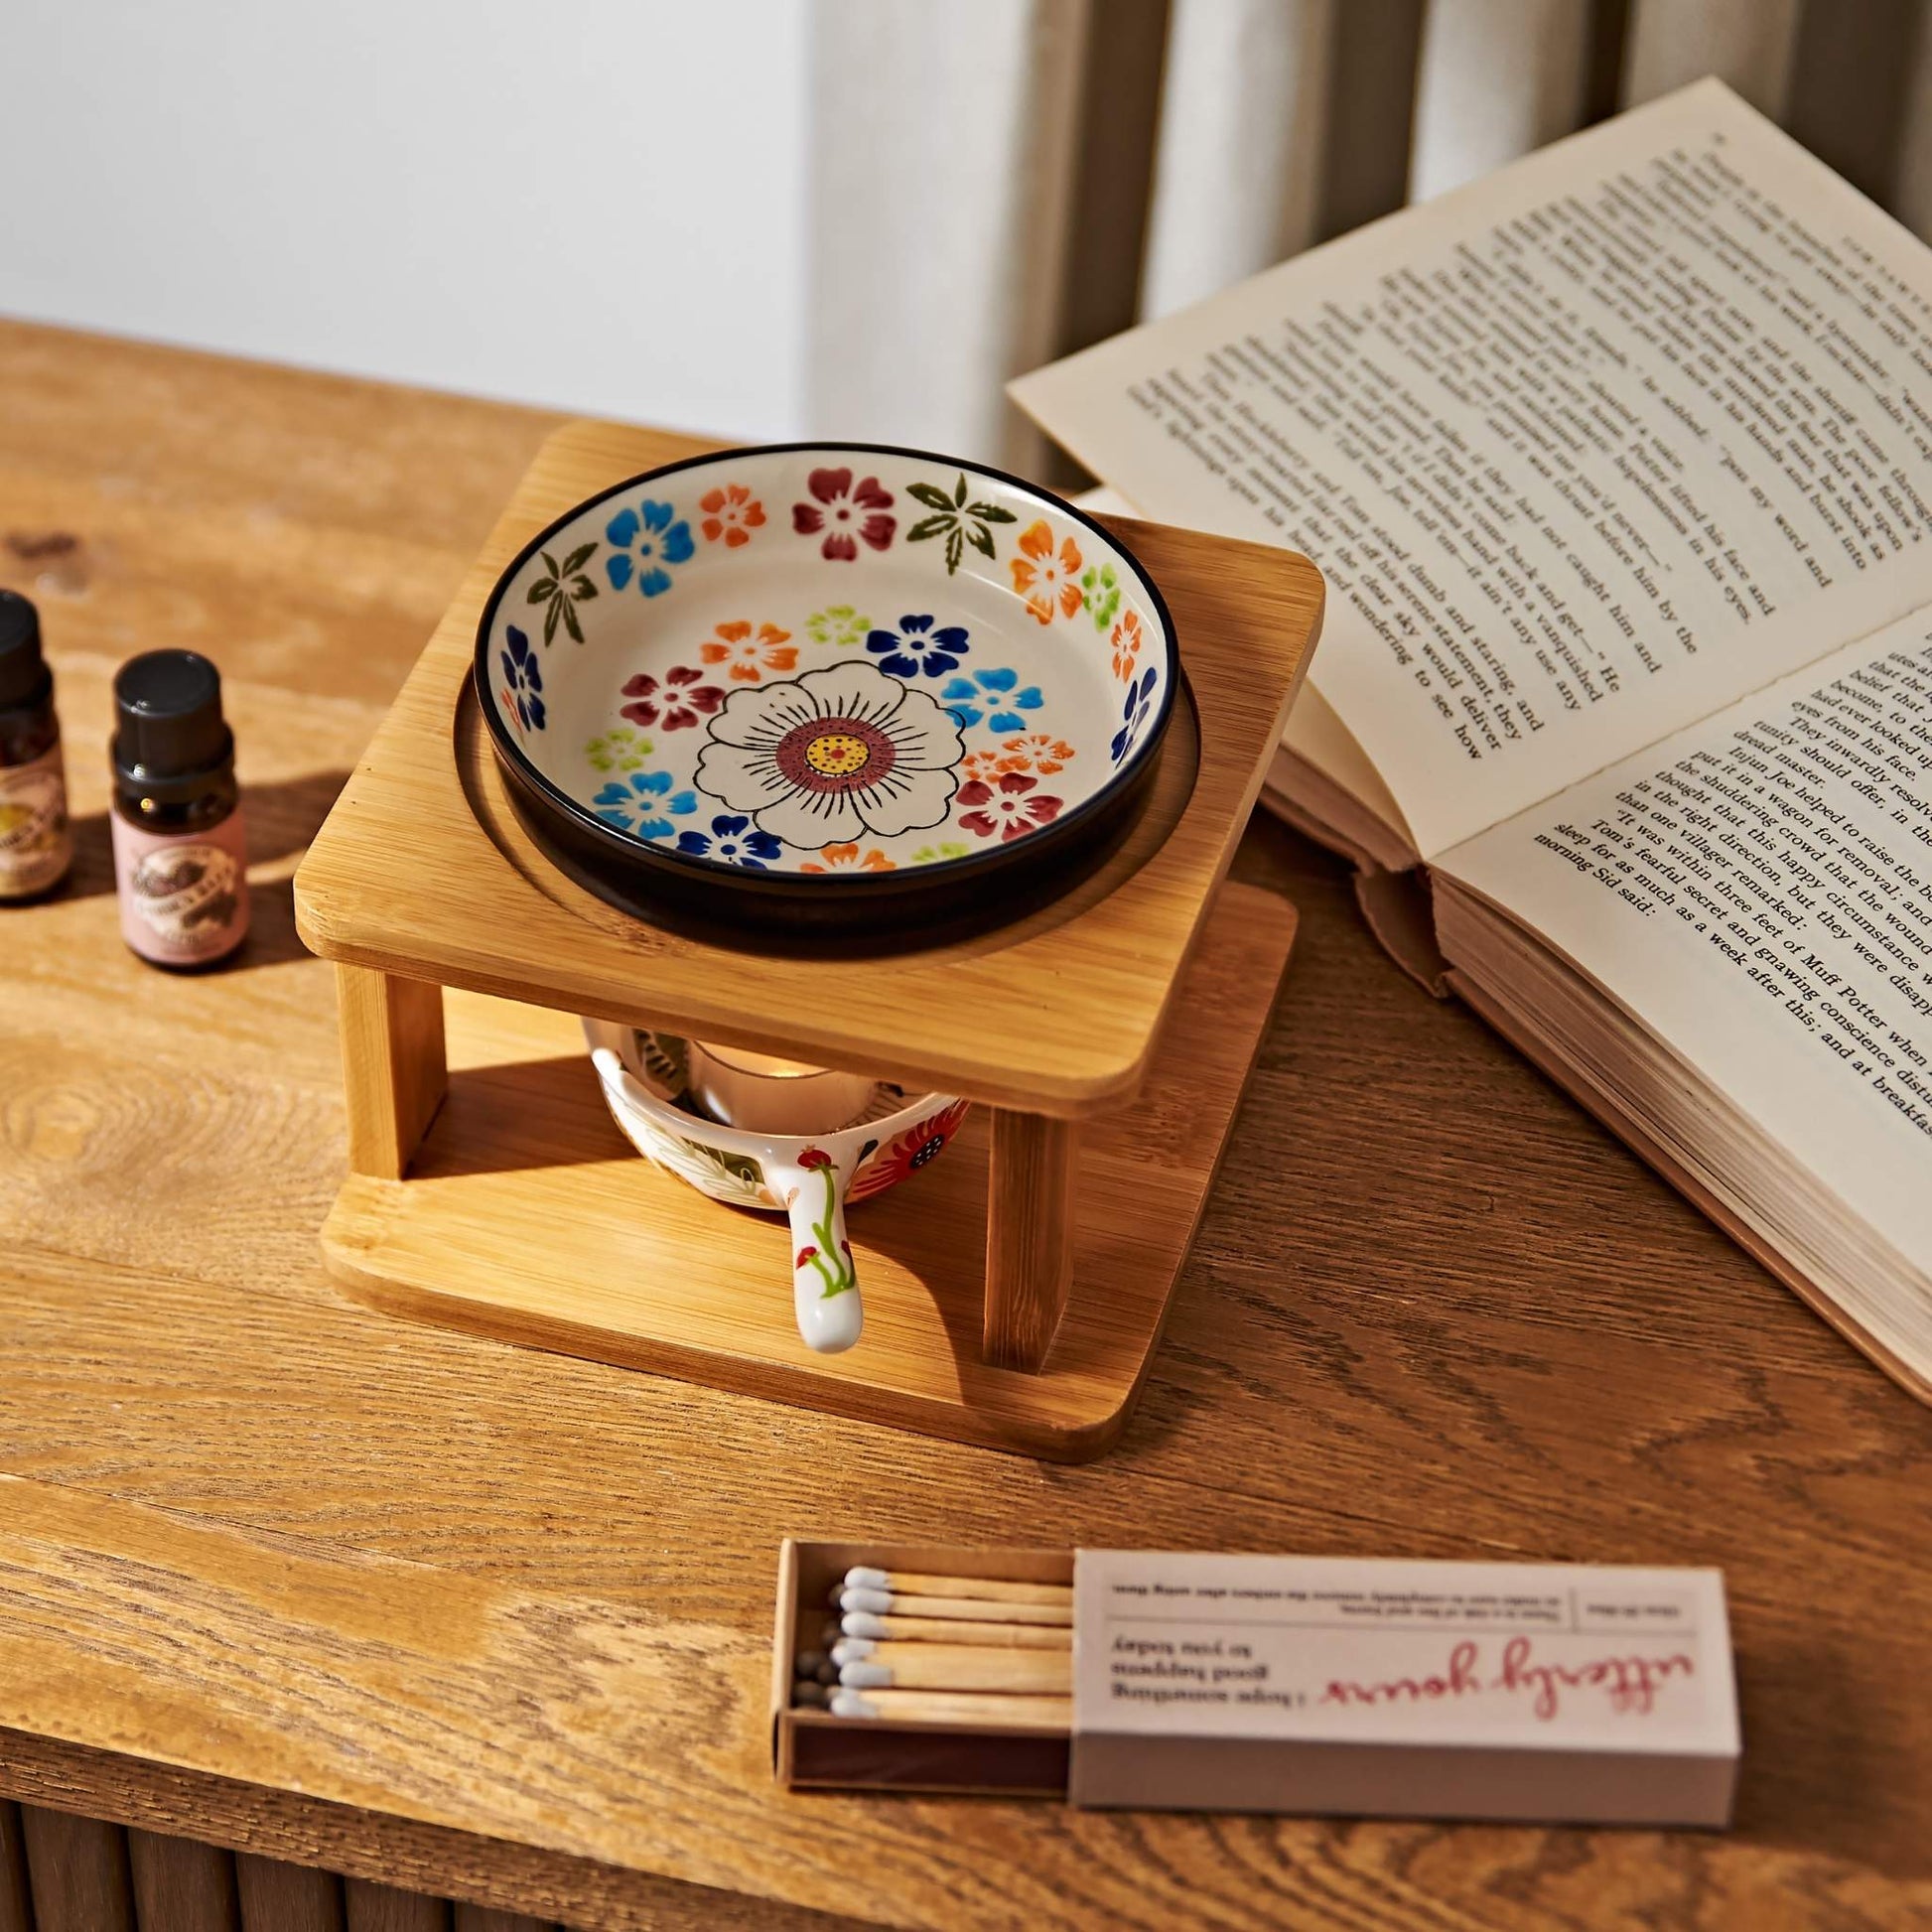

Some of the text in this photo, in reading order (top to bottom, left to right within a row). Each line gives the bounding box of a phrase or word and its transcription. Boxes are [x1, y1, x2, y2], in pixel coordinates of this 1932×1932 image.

[1845, 449, 1878, 480] poor
[1749, 486, 1833, 589] my word and
[1809, 493, 1866, 571] burst into
[1819, 475, 1885, 561] he shook as
[1851, 482, 1903, 552] was upon
[1688, 538, 1704, 556] in
[1704, 557, 1725, 583] his
[1704, 523, 1776, 617] his face and
[1524, 602, 1604, 703] a vanquished
[1536, 583, 1567, 611] and
[1599, 665, 1620, 693] He
[1566, 553, 1663, 674] caught him and
[1632, 566, 1697, 654] him by the
[1349, 592, 1482, 759] wondering to see how
[1422, 643, 1502, 750] would deliver
[1510, 618, 1582, 710] any use any
[1830, 679, 1906, 724] become, to
[1850, 669, 1925, 713] belief that
[1868, 661, 1925, 692] that the
[1887, 652, 1918, 668] utes
[1493, 703, 1522, 740] they
[1516, 700, 1545, 732] and
[1789, 716, 1827, 740] They
[1825, 738, 1891, 783] inwardly
[1791, 701, 1916, 781] eyes from his face.
[1811, 689, 1843, 707] had
[1839, 705, 1871, 724] ever
[1868, 720, 1921, 756] looked
[1733, 731, 1826, 789] dread master.
[1753, 721, 1799, 746] tunity
[1800, 747, 1853, 779] should
[1851, 780, 1886, 809] offer,
[1889, 808, 1908, 825] in
[1675, 761, 1700, 775] the
[1700, 775, 1779, 828] shuddering
[1778, 827, 1827, 862] crowd
[1824, 862, 1859, 890] that
[1858, 890, 1883, 911] the
[1690, 751, 1722, 766] put
[1721, 763, 1737, 775] it
[1735, 772, 1753, 786] in
[1753, 785, 1765, 794] a
[1768, 793, 1814, 828] wagon
[1813, 827, 1840, 846] for
[1837, 847, 1903, 900] removal;
[1728, 747, 1920, 887] Injun Joe helped to raise the
[1534, 834, 1656, 916] morning Sid said:
[1615, 792, 1808, 930] than one villager remarked:
[1634, 779, 1651, 793] in
[1653, 791, 1679, 807] the
[1679, 807, 1719, 832] right
[1719, 833, 1781, 887] direction,
[1786, 885, 1817, 910] but
[1816, 910, 1853, 939] they
[1854, 941, 1888, 973] were
[1655, 771, 1919, 971] thought that this happy circumstance
[1554, 824, 1590, 845] sleep
[1590, 844, 1616, 860] for
[1615, 861, 1635, 874] as
[1633, 874, 1676, 906] much
[1676, 906, 1696, 921] as
[1694, 922, 1708, 933] a
[1710, 932, 1748, 967] week
[1746, 967, 1786, 998] after
[1785, 1000, 1822, 1033] this;
[1821, 1033, 1856, 1059] and
[1852, 1060, 1873, 1076] at
[1634, 848, 1687, 885] fearful
[1683, 885, 1728, 920] secret
[1726, 921, 1762, 947] and
[1754, 947, 1821, 1001] gnawing
[1820, 1002, 1895, 1068] conscience
[1637, 825, 1665, 846] was
[1666, 845, 1713, 882] within
[1714, 881, 1752, 913] three
[1751, 913, 1784, 939] feet
[1783, 940, 1806, 955] of
[1800, 953, 1843, 987] Muff
[1837, 985, 1888, 1029] Potter
[1888, 1031, 1928, 1067] when
[1112, 1635, 1174, 1656] today
[1319, 1636, 1694, 1722] utterly yours
[1112, 1682, 1229, 1707] something
[1237, 1687, 1291, 1709] hope
